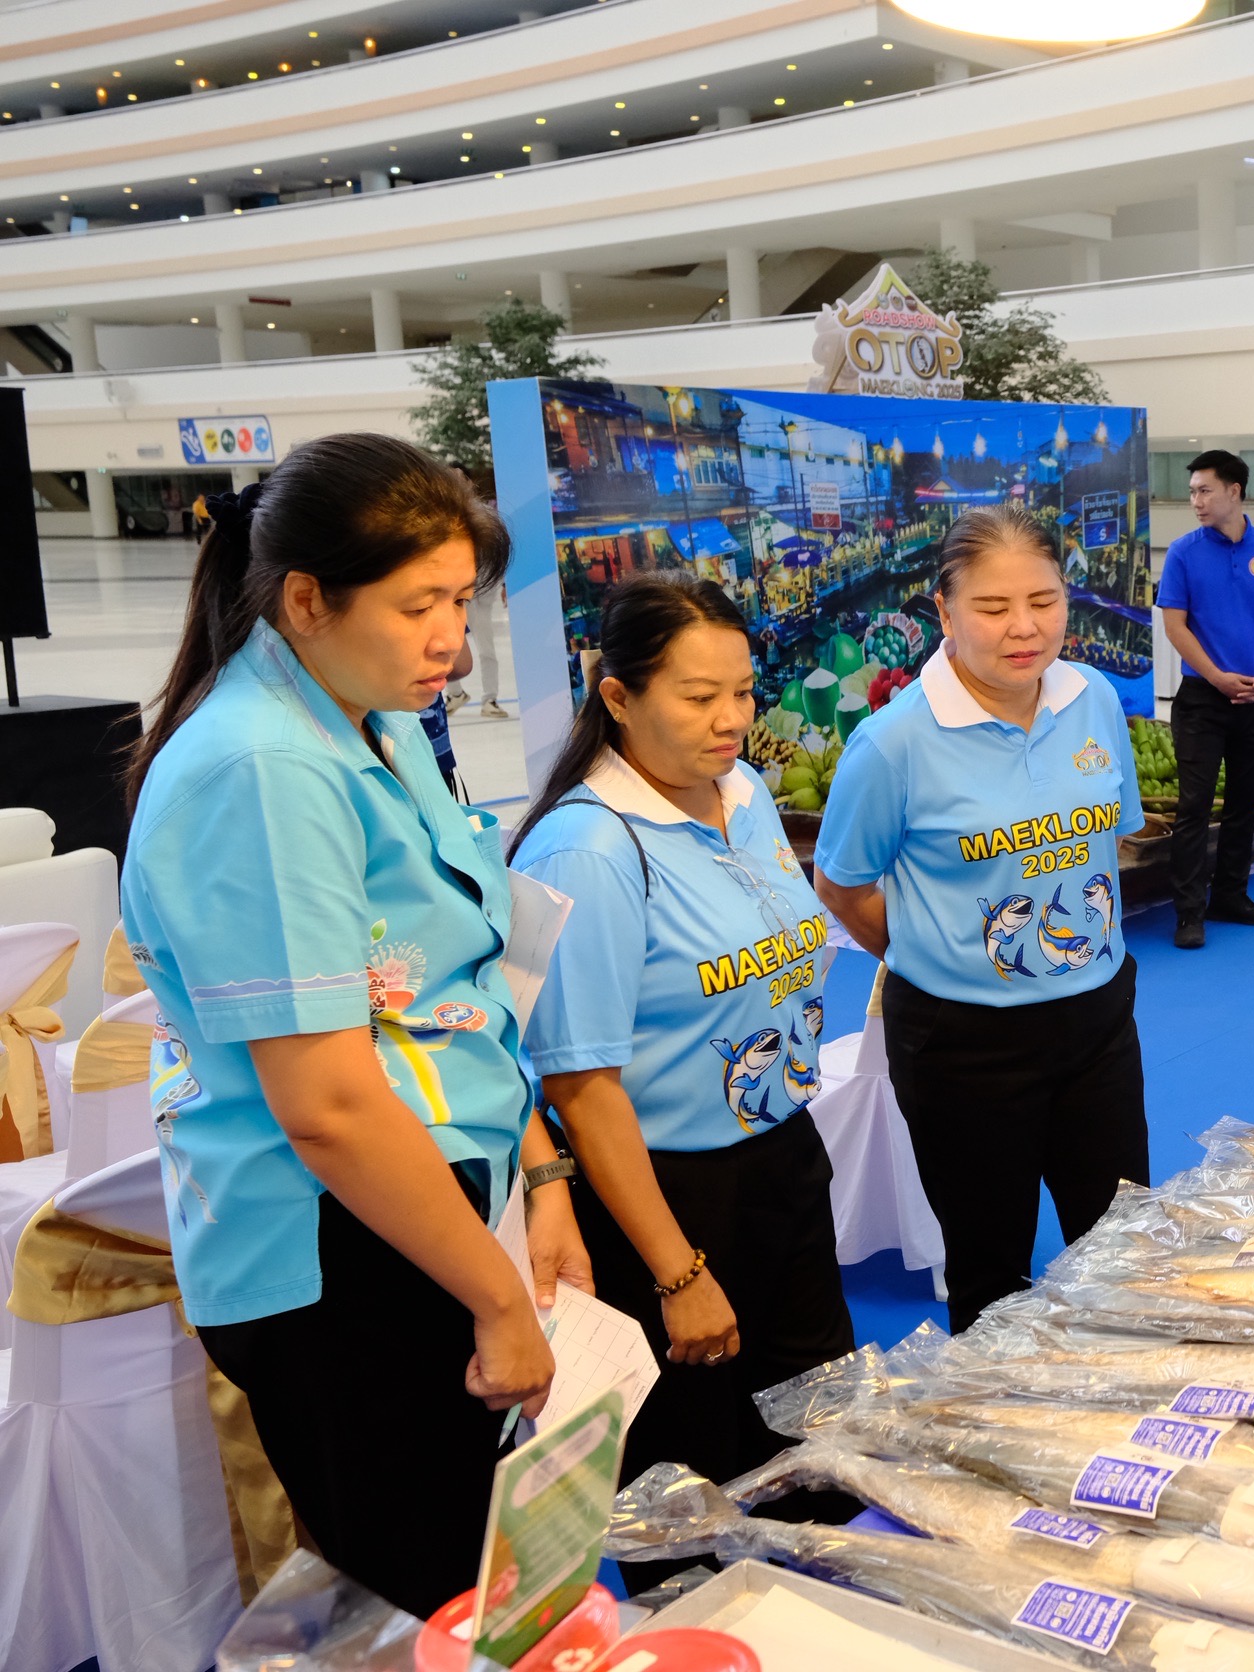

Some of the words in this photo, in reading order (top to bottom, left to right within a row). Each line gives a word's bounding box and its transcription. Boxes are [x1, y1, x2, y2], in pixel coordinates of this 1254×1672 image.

[863, 309, 937, 331] ROADSHOW
[849, 328, 962, 379] OTOP
[860, 378, 934, 398] MAEKLONG
[958, 801, 1121, 862] MAEKLONG
[1021, 841, 1090, 879] 2025
[769, 959, 815, 1009] 2025
